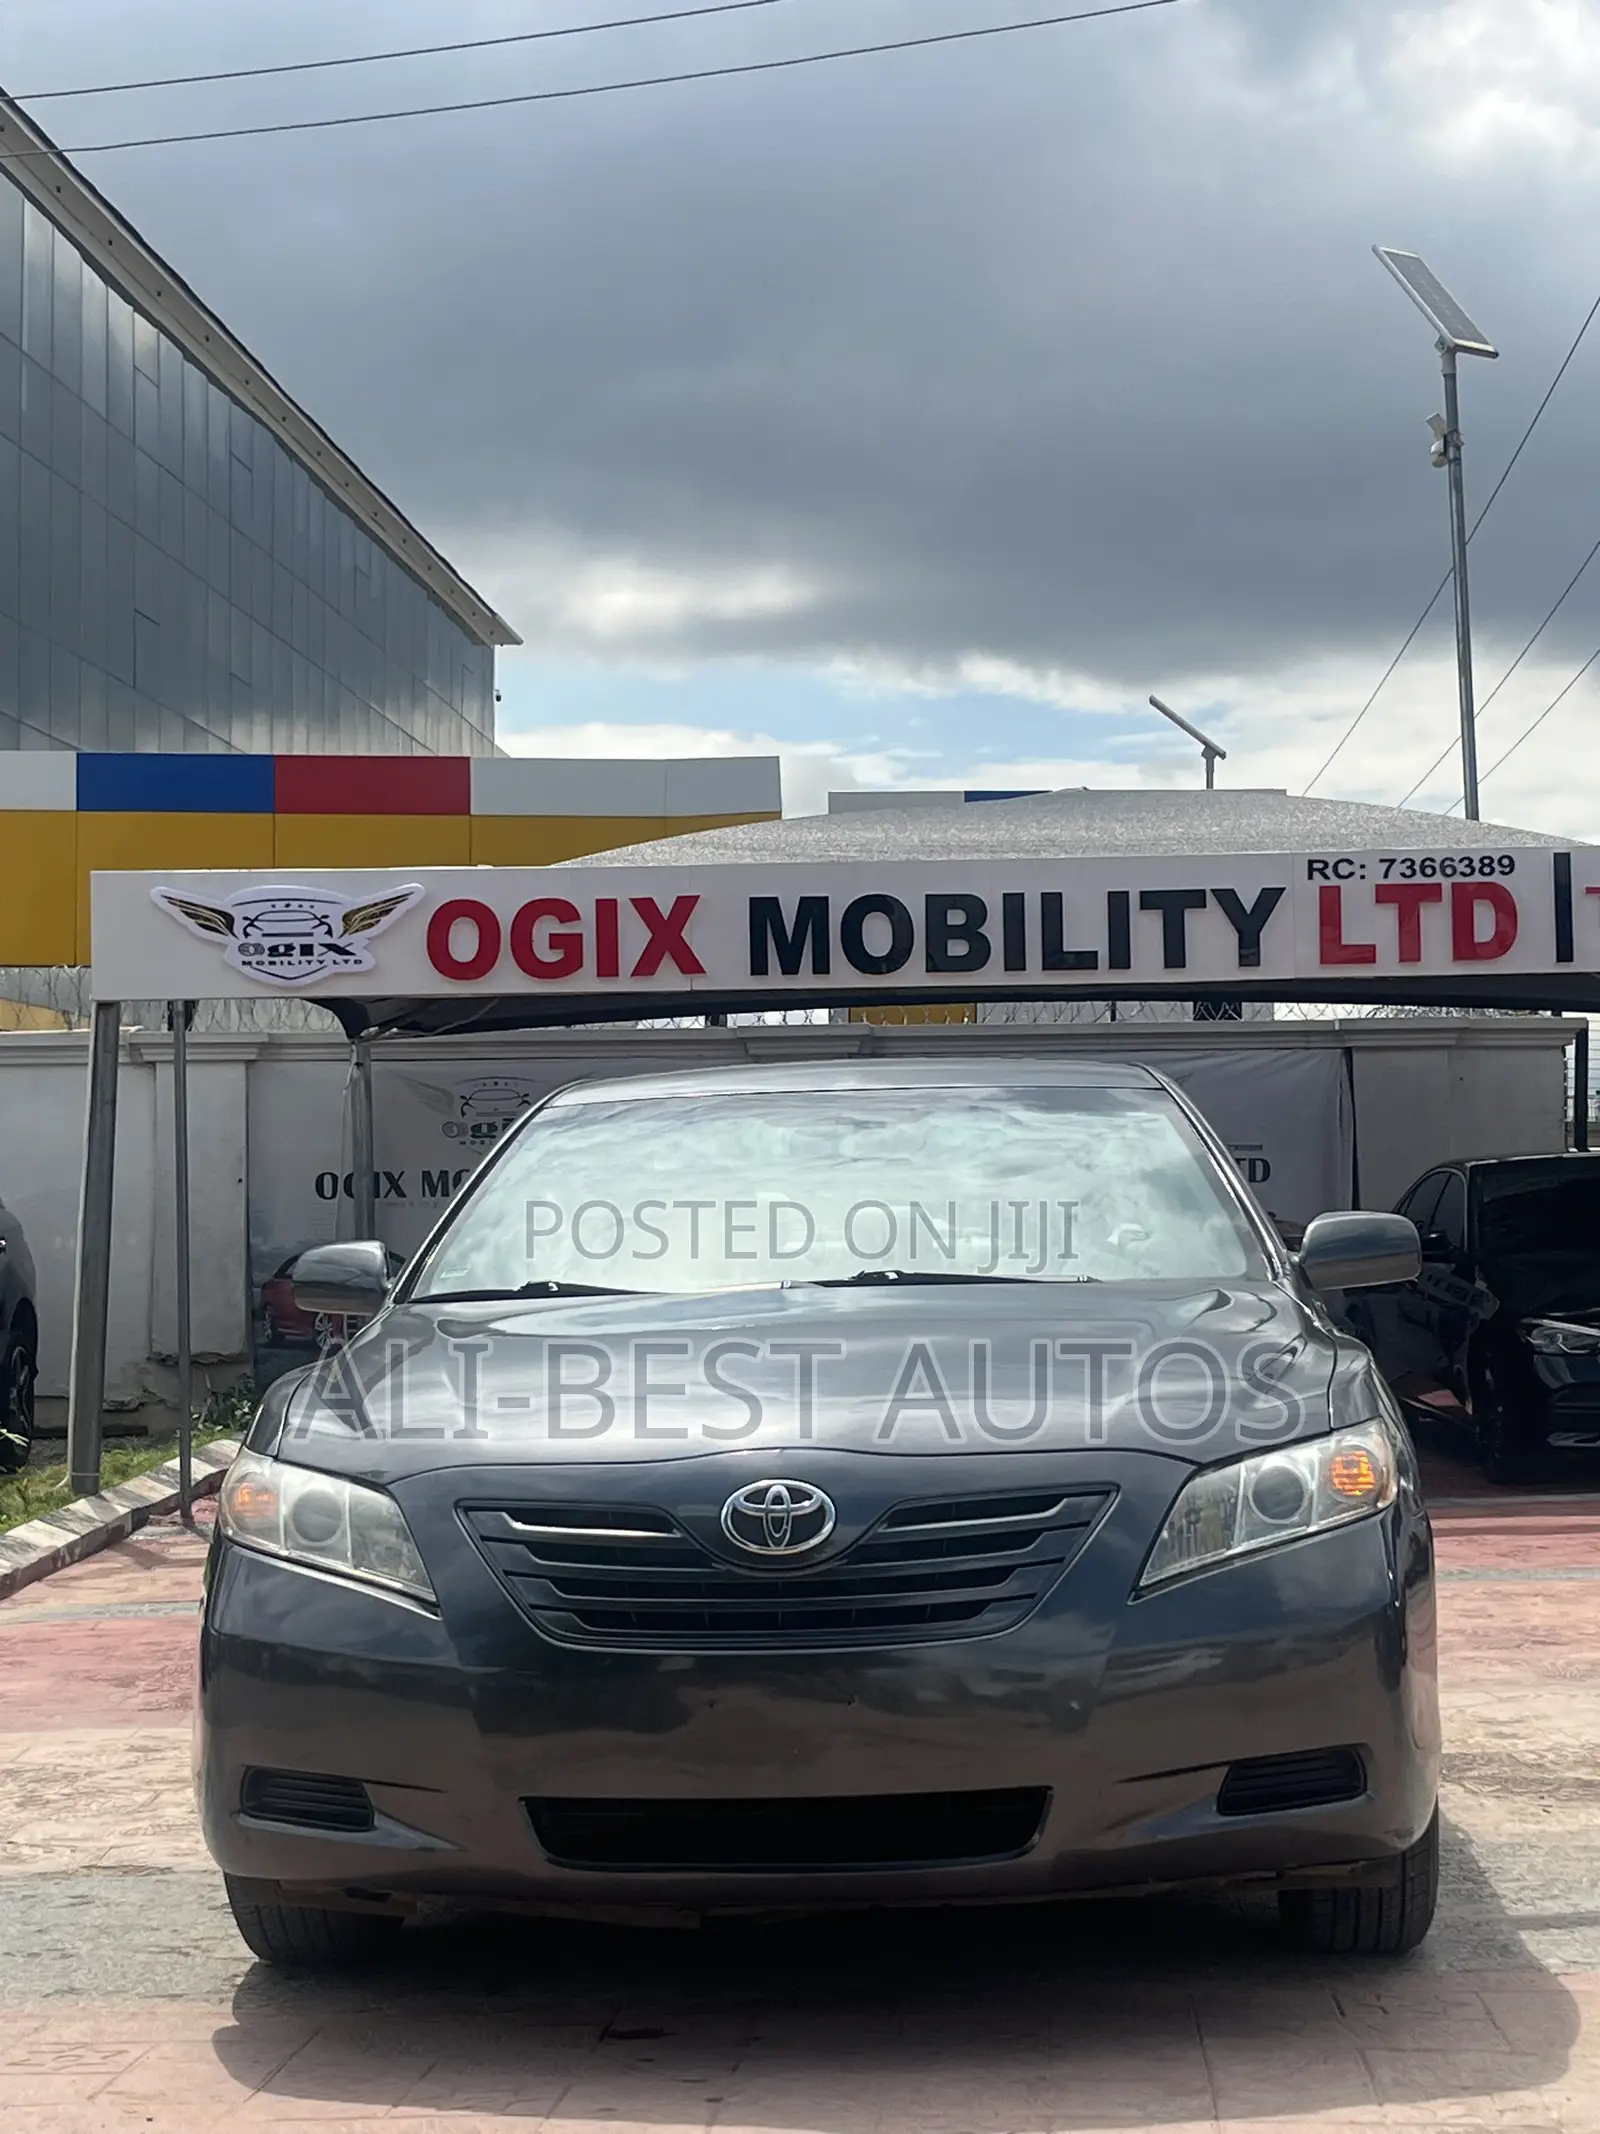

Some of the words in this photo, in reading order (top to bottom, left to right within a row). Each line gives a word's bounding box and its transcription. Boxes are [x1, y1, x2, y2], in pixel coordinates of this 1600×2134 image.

[1306, 859, 1367, 881] RC:
[1378, 854, 1515, 880] 7366389
[426, 894, 706, 981] OGIX
[748, 886, 1287, 977] MOBILITY
[1318, 881, 1518, 966] LTD
